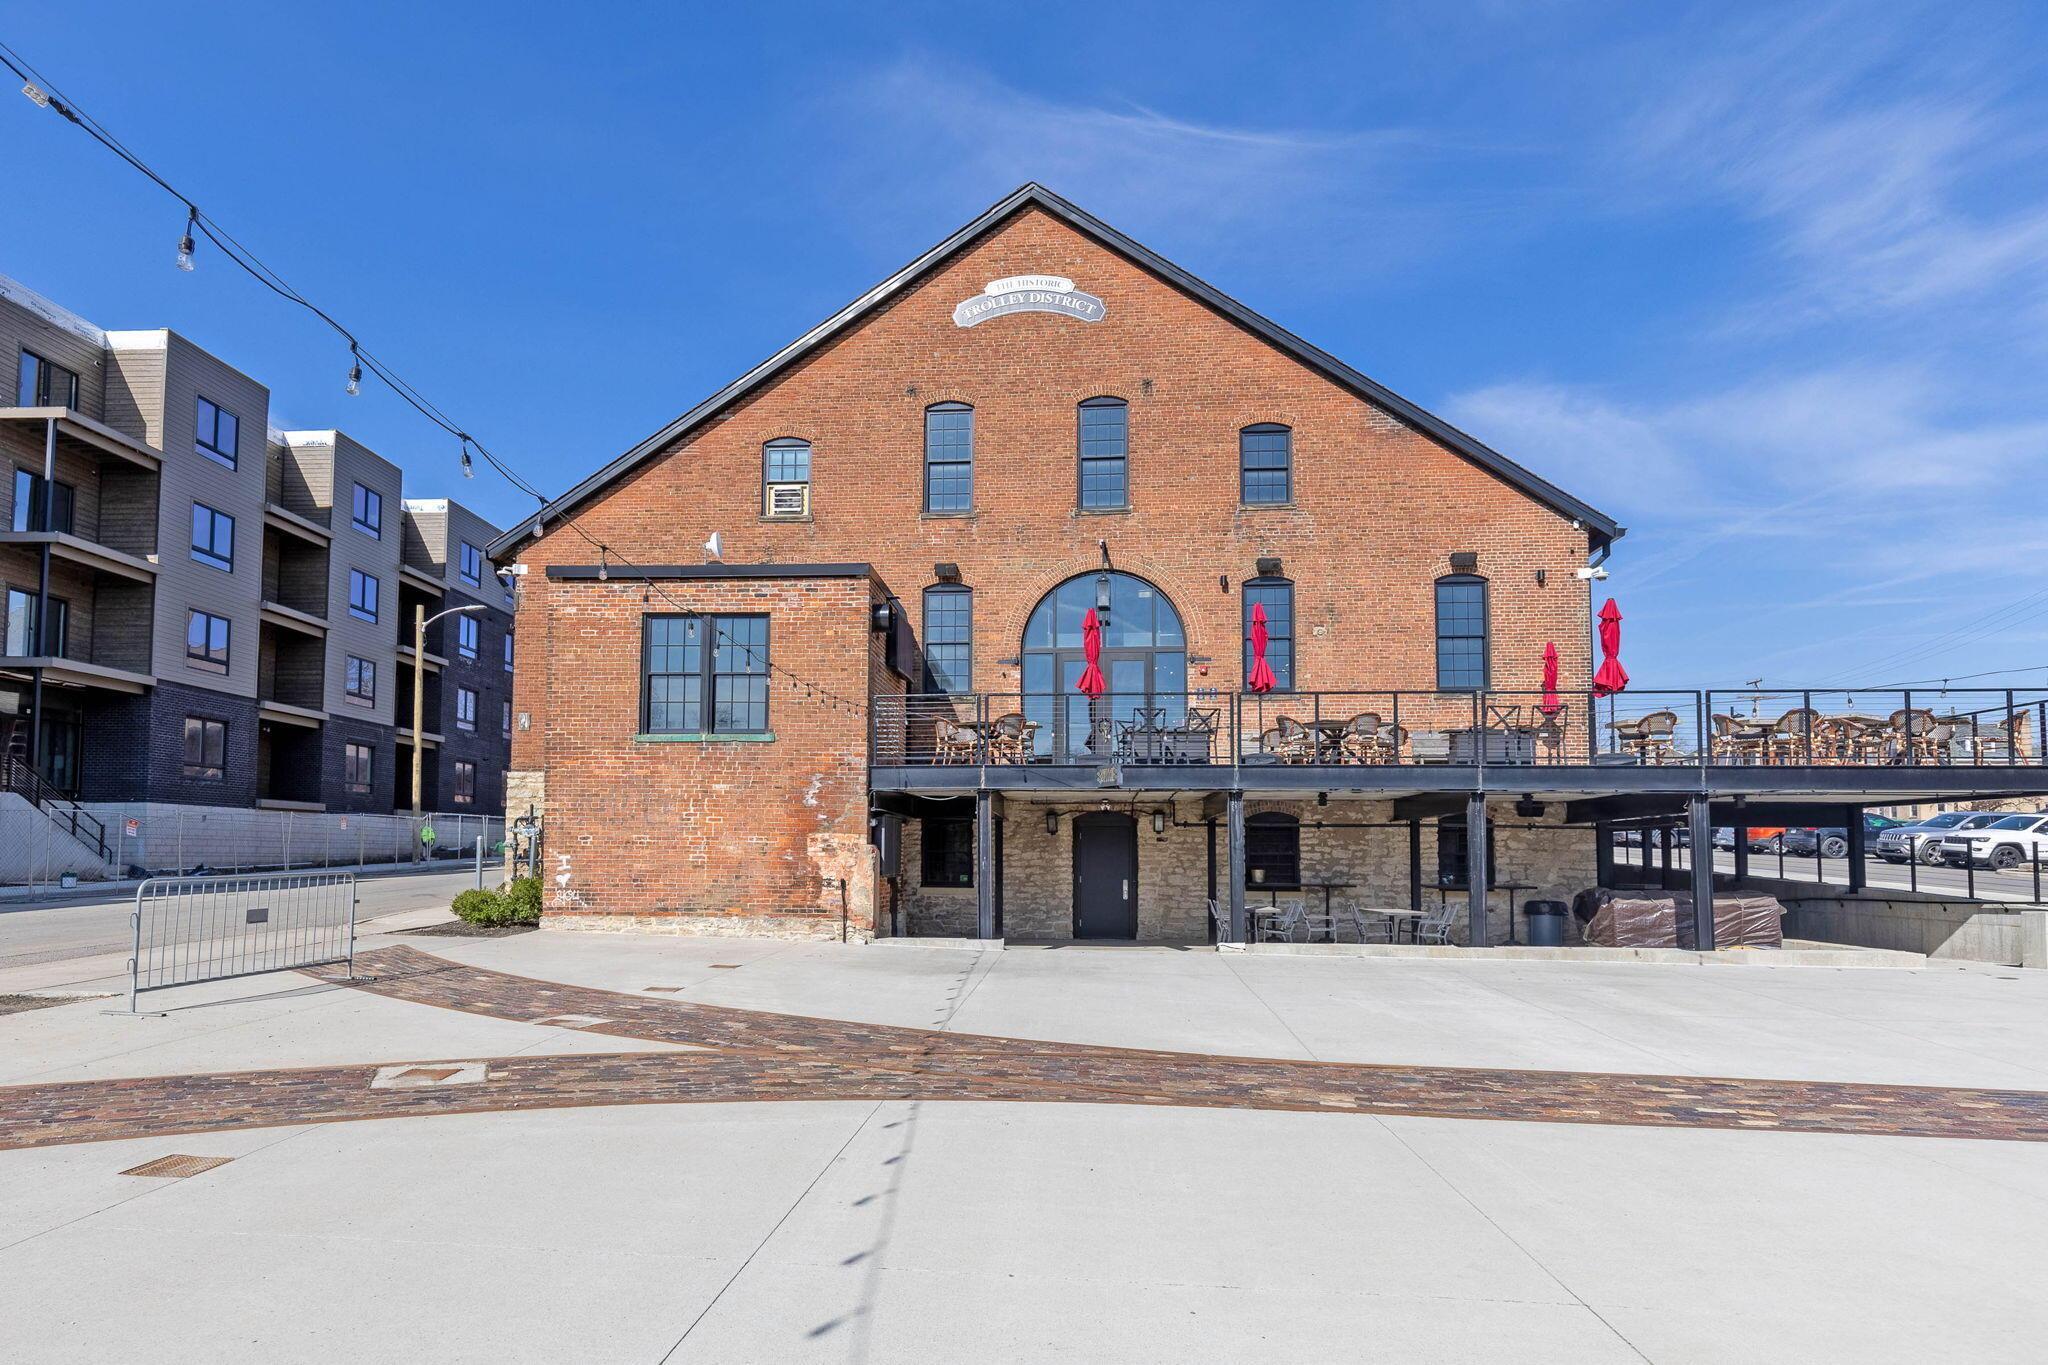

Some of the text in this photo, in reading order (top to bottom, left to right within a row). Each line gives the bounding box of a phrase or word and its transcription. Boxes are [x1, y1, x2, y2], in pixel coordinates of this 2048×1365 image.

[1017, 279, 1063, 289] HISTORIC
[961, 292, 1098, 320] TROLLEY DISTRICT
